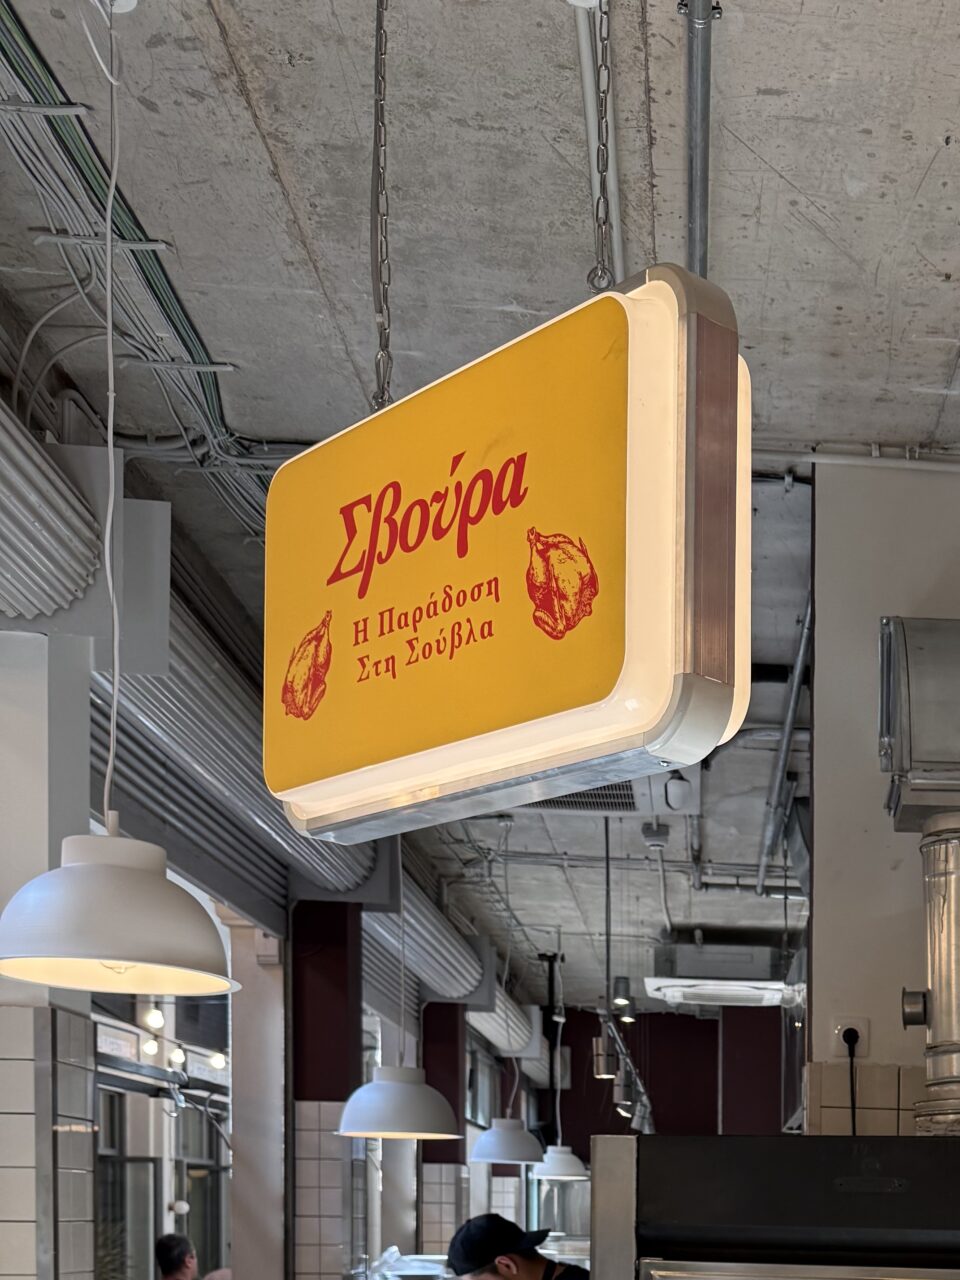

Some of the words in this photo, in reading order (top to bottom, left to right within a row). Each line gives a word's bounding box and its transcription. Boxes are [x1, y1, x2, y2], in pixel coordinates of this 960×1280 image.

[326, 450, 528, 600] Σβούρα
[353, 617, 370, 647] Η
[377, 576, 500, 640] Παράδοση
[356, 652, 396, 683] Στη
[405, 619, 494, 667] Σούβλα
